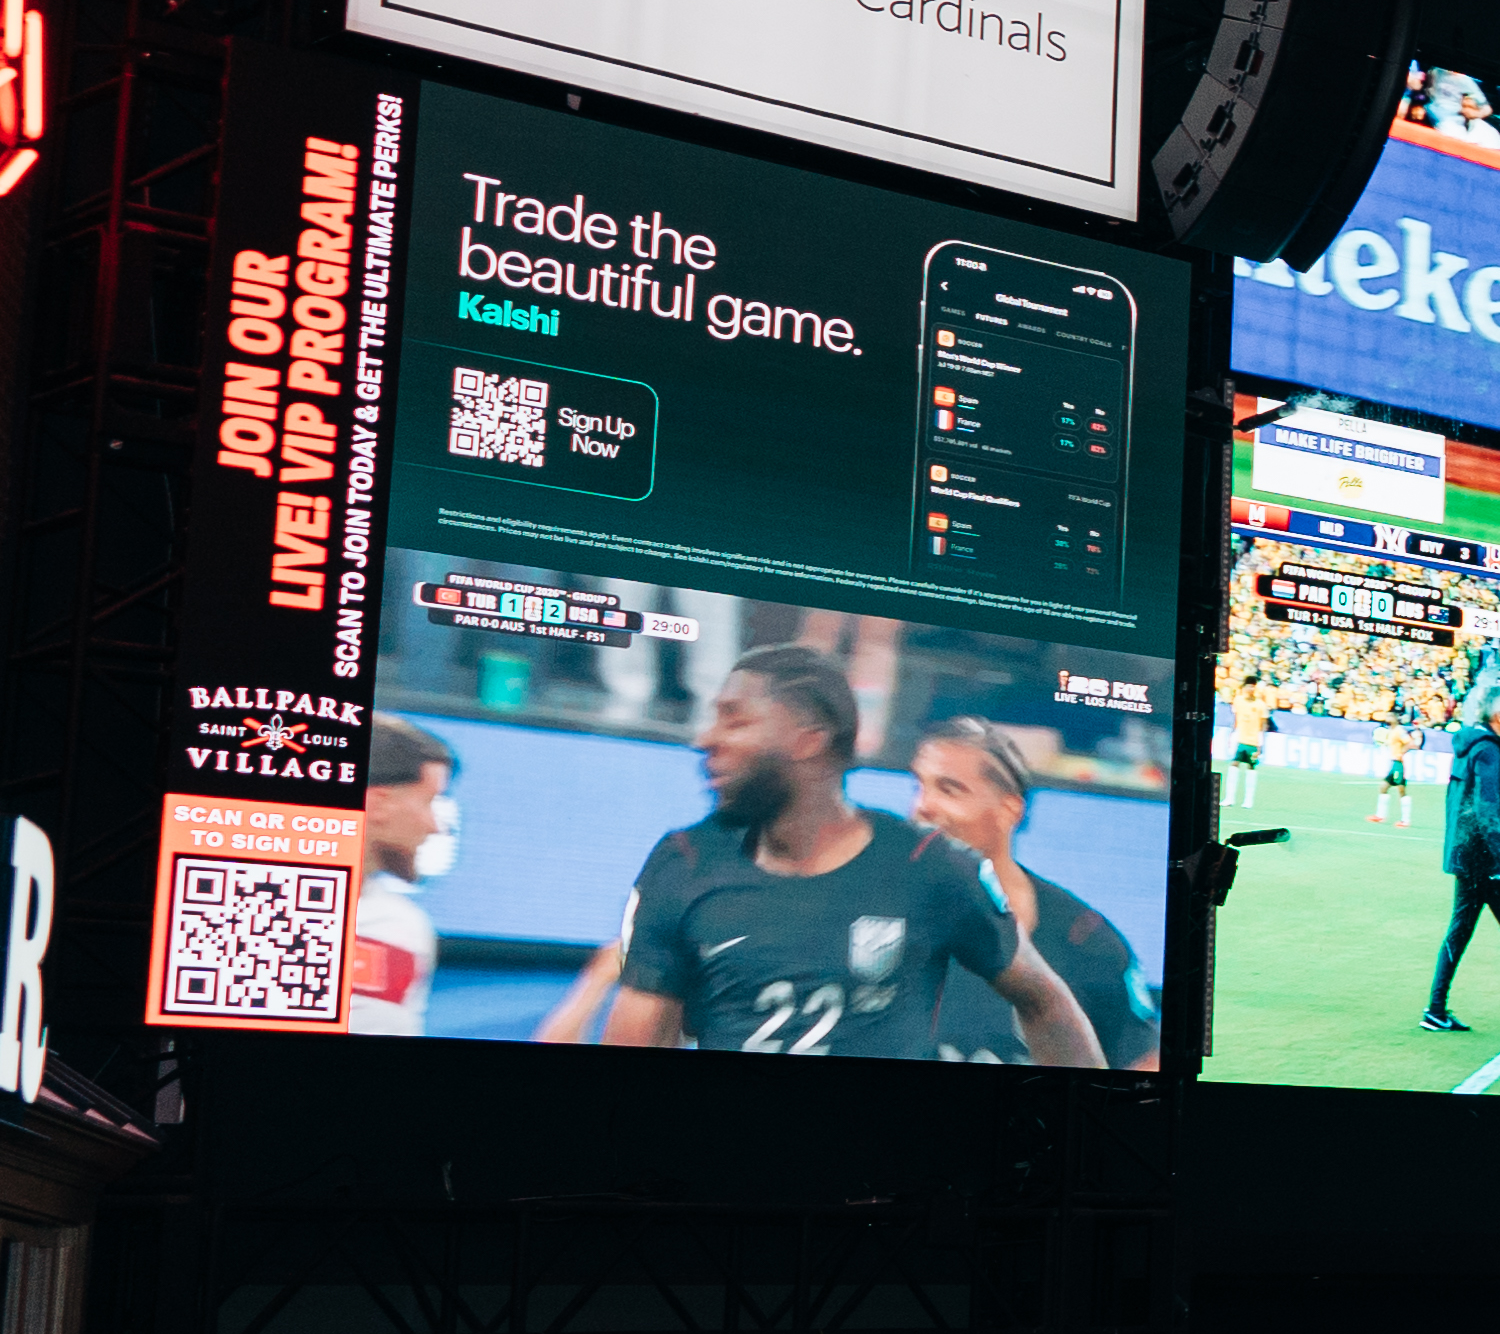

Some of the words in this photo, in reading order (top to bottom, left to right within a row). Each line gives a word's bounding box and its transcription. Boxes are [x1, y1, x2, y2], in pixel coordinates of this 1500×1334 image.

[372, 94, 402, 179] PERKS!
[463, 173, 619, 249] Trade
[630, 212, 717, 270] the
[363, 180, 396, 299] ULTIMATE
[287, 137, 361, 395] PROGRAM!
[229, 250, 290, 355] OUR
[459, 226, 696, 322] beautiful
[707, 293, 863, 356] game.
[358, 301, 387, 348] THE
[458, 291, 560, 336] Kalshi
[356, 351, 383, 400] GET
[354, 406, 379, 423] &
[957, 394, 980, 405] Spain
[217, 362, 283, 478] JOIN
[557, 407, 602, 437] Sign
[605, 416, 636, 439] Up
[956, 417, 982, 428] France
[1338, 417, 1368, 434] PELLA
[279, 402, 340, 483] VIP
[571, 434, 620, 459] Now
[1275, 428, 1319, 450] MAKE
[1320, 437, 1354, 457] LIFE
[1354, 444, 1426, 471] BRIGHTER
[346, 424, 377, 504] TODAY
[342, 508, 372, 568] JOIN
[1319, 520, 1346, 537] MLB
[269, 491, 333, 611] LIVE!
[339, 571, 366, 604] TO
[448, 574, 474, 586] FIFA
[473, 577, 513, 592] WORLD
[513, 583, 535, 594] CUP
[572, 591, 604, 605] GROUP
[606, 596, 617, 607] D
[1282, 564, 1305, 578] FIFA
[1305, 569, 1343, 586] WORLD
[466, 591, 498, 611] TUR
[568, 606, 599, 624] USA
[1298, 585, 1330, 605] PAR
[1395, 600, 1425, 620] AUS
[454, 613, 480, 627] PAR
[500, 619, 526, 633] AUS
[529, 623, 548, 636] 1st
[548, 626, 578, 640] HALF
[651, 619, 691, 636] 29:00
[1287, 608, 1313, 624] TUR
[1330, 614, 1355, 629] USA
[1357, 620, 1375, 634] 1st
[1375, 622, 1404, 638] HALF
[1410, 628, 1435, 643] FOX
[333, 609, 363, 678] SCAN
[188, 686, 364, 726] BALLPARK
[1054, 691, 1079, 704] LIVE
[1084, 696, 1107, 708] LOS
[1106, 699, 1153, 714] ANGELES
[1112, 681, 1150, 703] FOX
[199, 722, 248, 737] SAINT
[302, 733, 349, 748] LOUIS
[186, 747, 357, 783] VILLAGE
[173, 805, 243, 827] SCAN
[249, 812, 286, 830] QR
[291, 816, 358, 836] CODE
[190, 829, 224, 848] TO
[231, 833, 291, 853] SIGN
[298, 839, 339, 857] UP!
